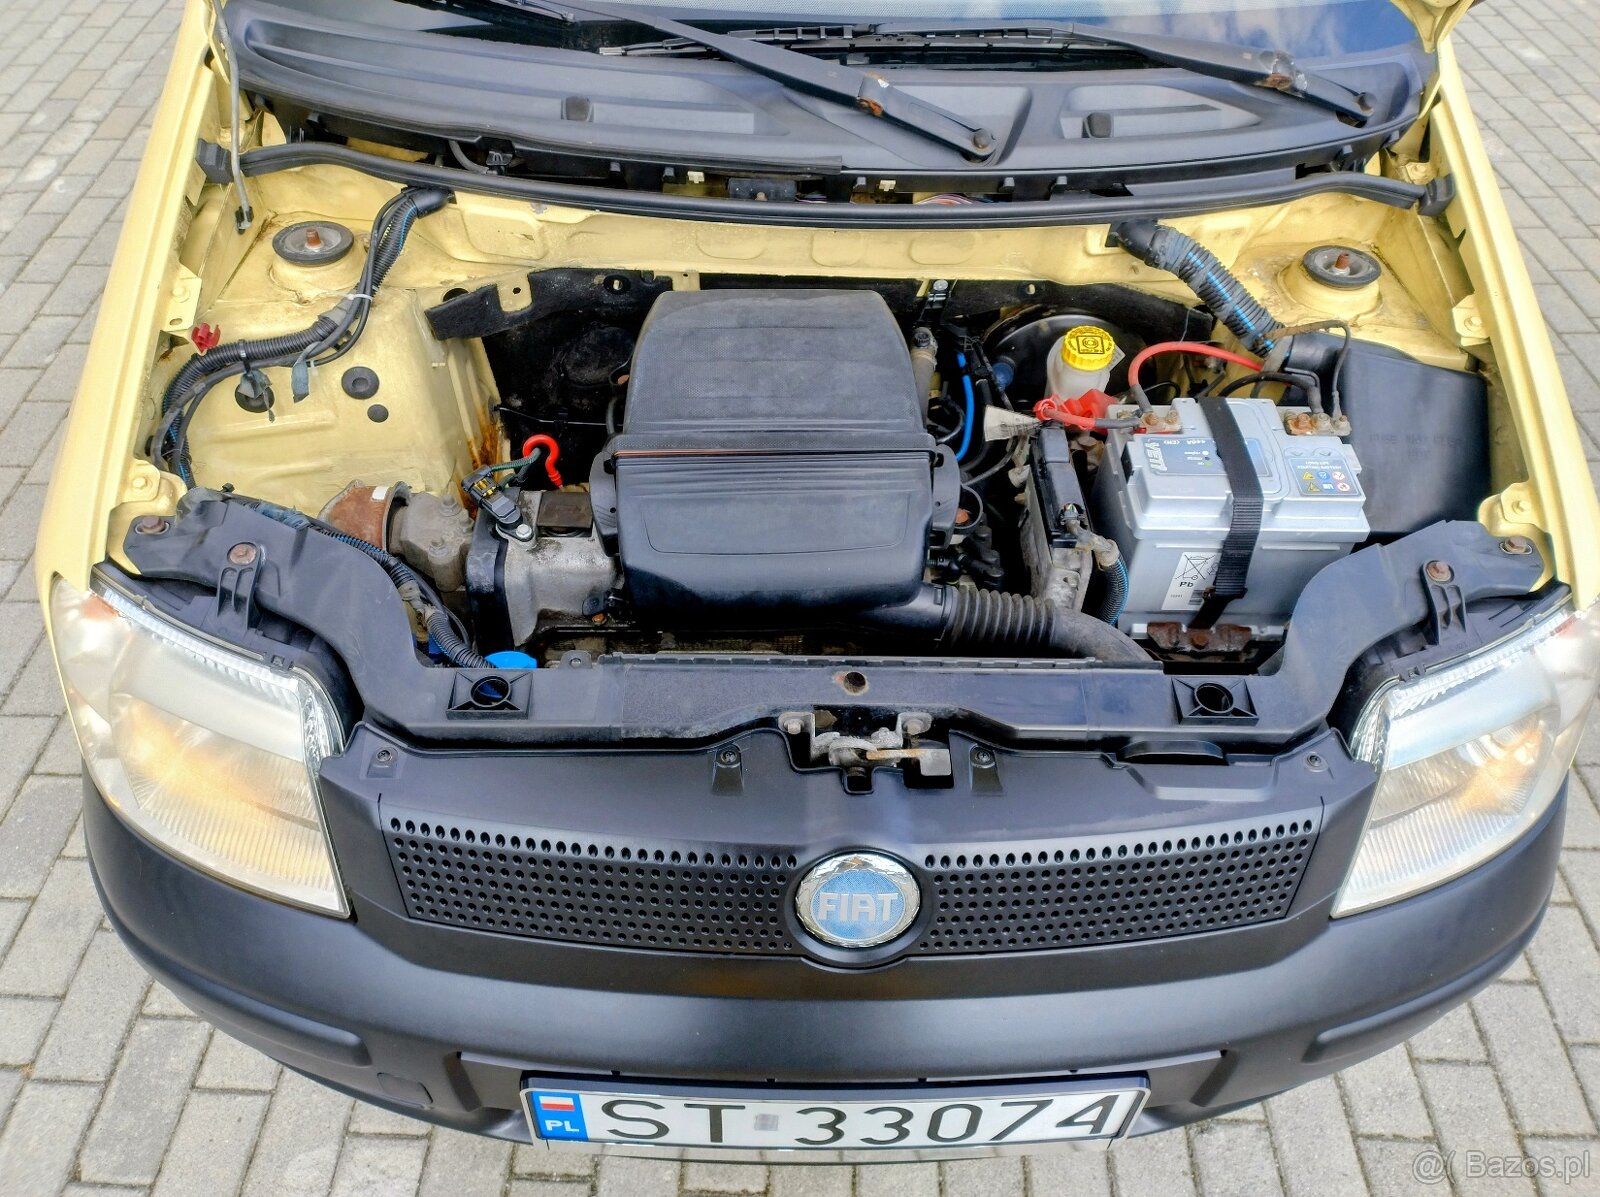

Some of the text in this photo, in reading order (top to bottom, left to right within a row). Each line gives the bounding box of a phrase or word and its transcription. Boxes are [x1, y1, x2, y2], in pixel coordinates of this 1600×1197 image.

[817, 892, 899, 922] FIAT
[544, 1119, 580, 1132] PL
[601, 1094, 1120, 1146] ST 33074
